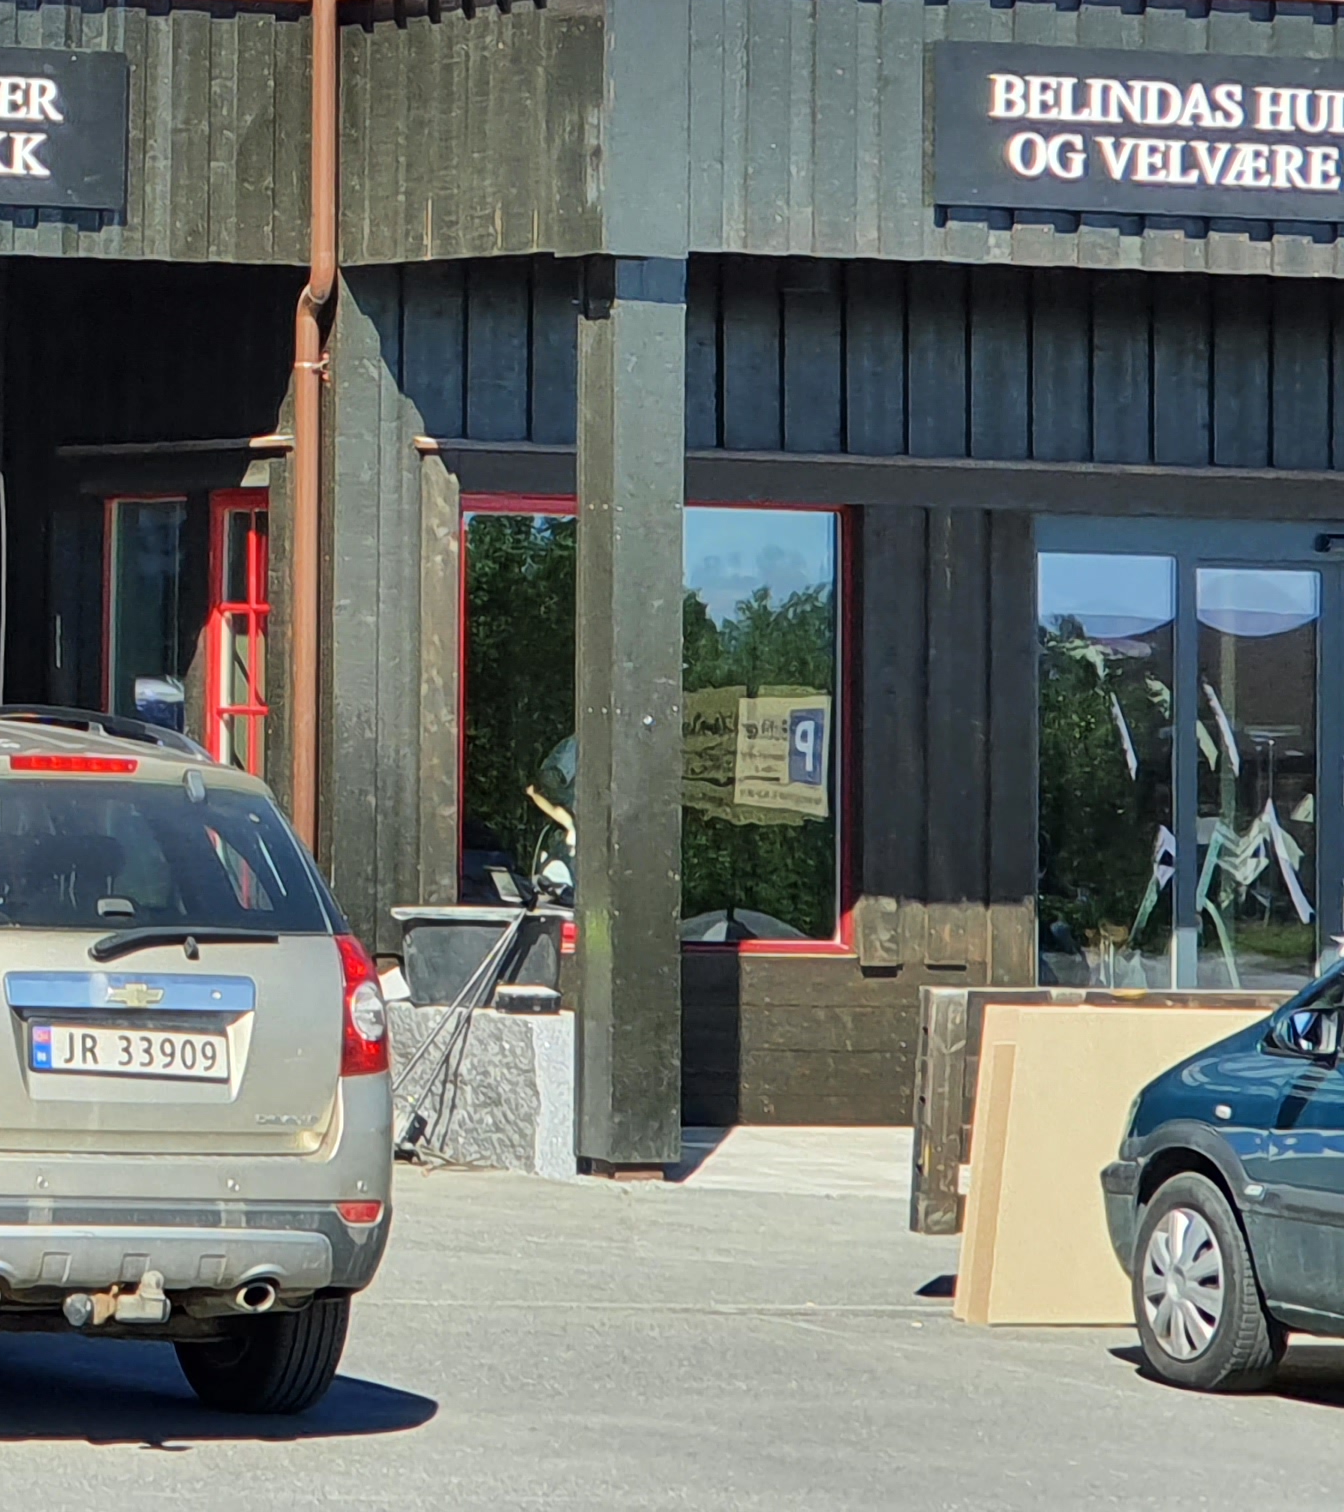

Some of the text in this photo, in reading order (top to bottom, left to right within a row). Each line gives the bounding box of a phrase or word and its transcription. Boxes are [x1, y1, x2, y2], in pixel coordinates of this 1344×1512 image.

[988, 73, 1244, 130] BELINDAS
[1008, 132, 1342, 190] OG VELVÆRE
[64, 1032, 218, 1072] JR 33909
